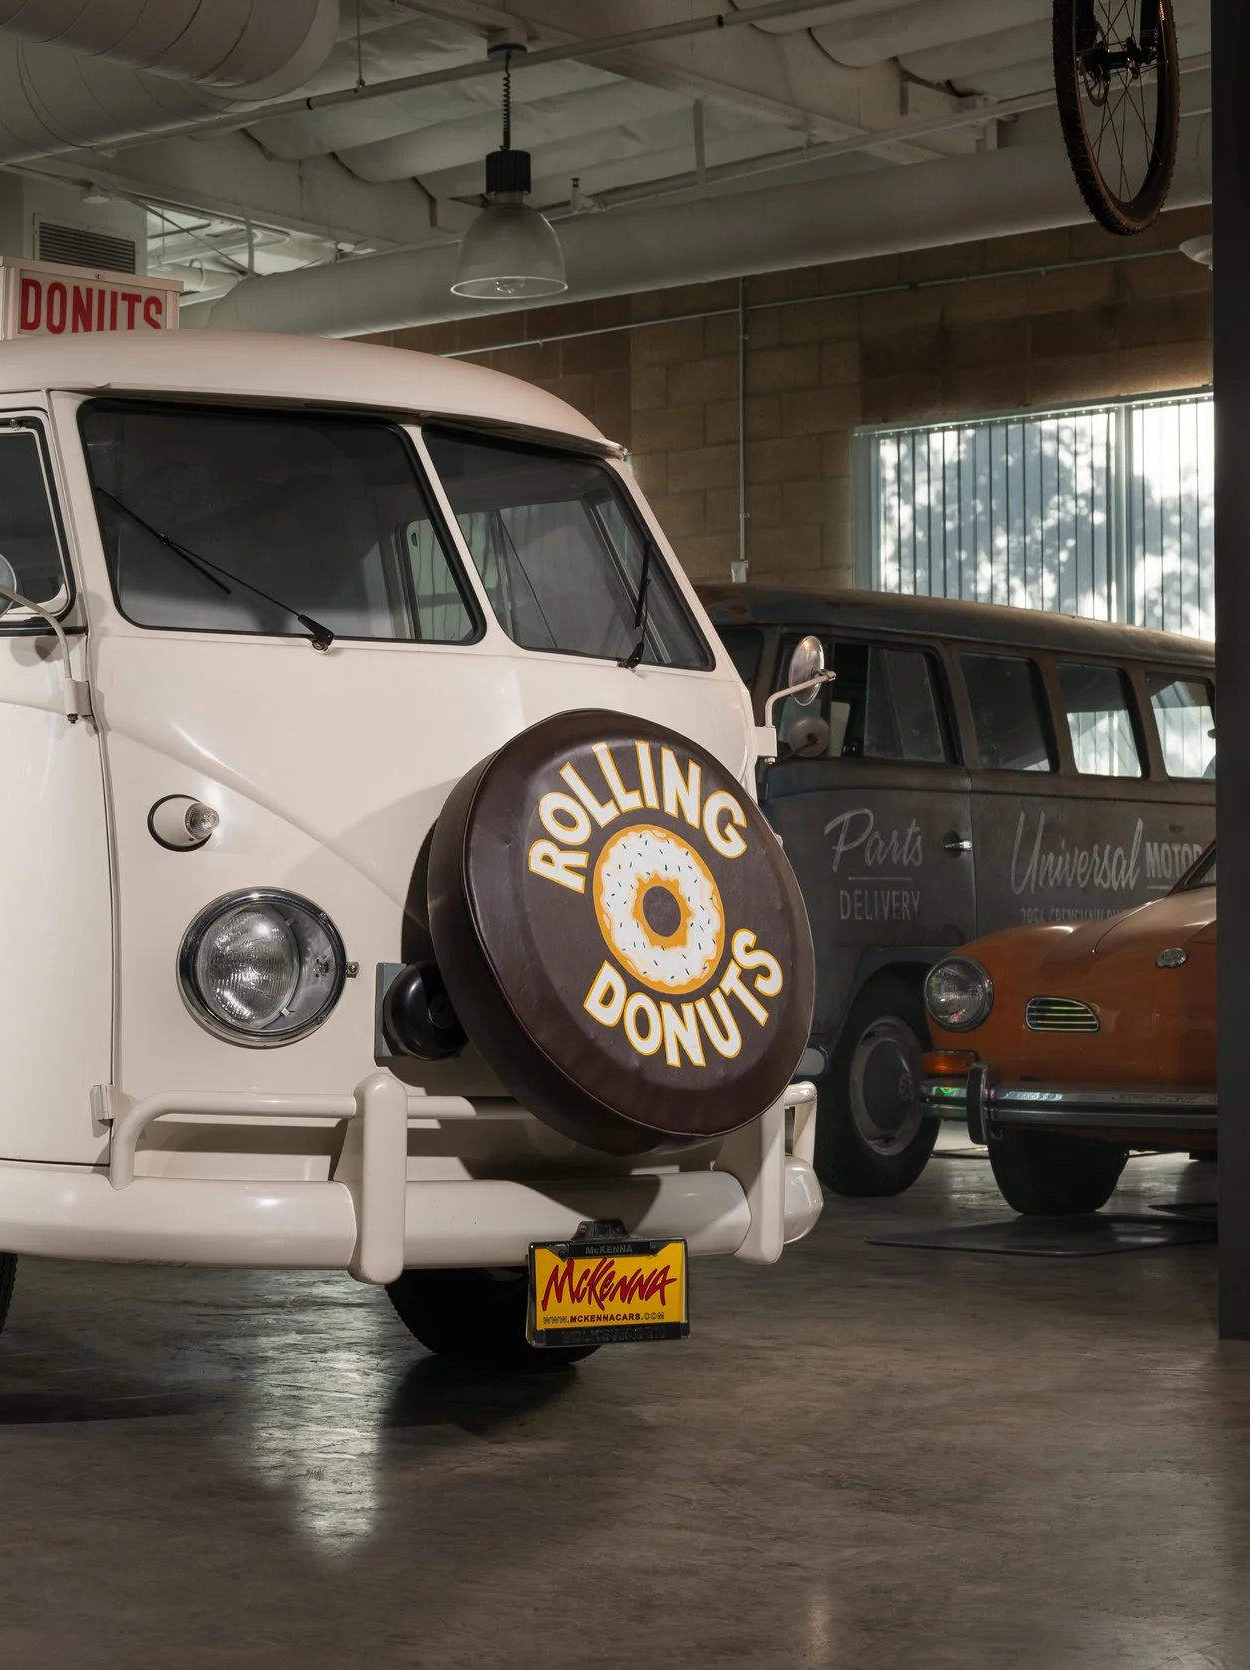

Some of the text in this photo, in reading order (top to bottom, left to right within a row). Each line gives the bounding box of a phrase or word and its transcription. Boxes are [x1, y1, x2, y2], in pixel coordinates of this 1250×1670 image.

[21, 278, 163, 334] DONUTS
[529, 740, 748, 894] ROLLING
[824, 808, 924, 872] Parts
[1010, 810, 1144, 895] Universal
[839, 890, 921, 920] DELIVERY
[583, 928, 783, 1068] DONUTS
[585, 1244, 633, 1255] McKENNA
[543, 1312, 665, 1325] WWW.MCKENNACARS.COM
